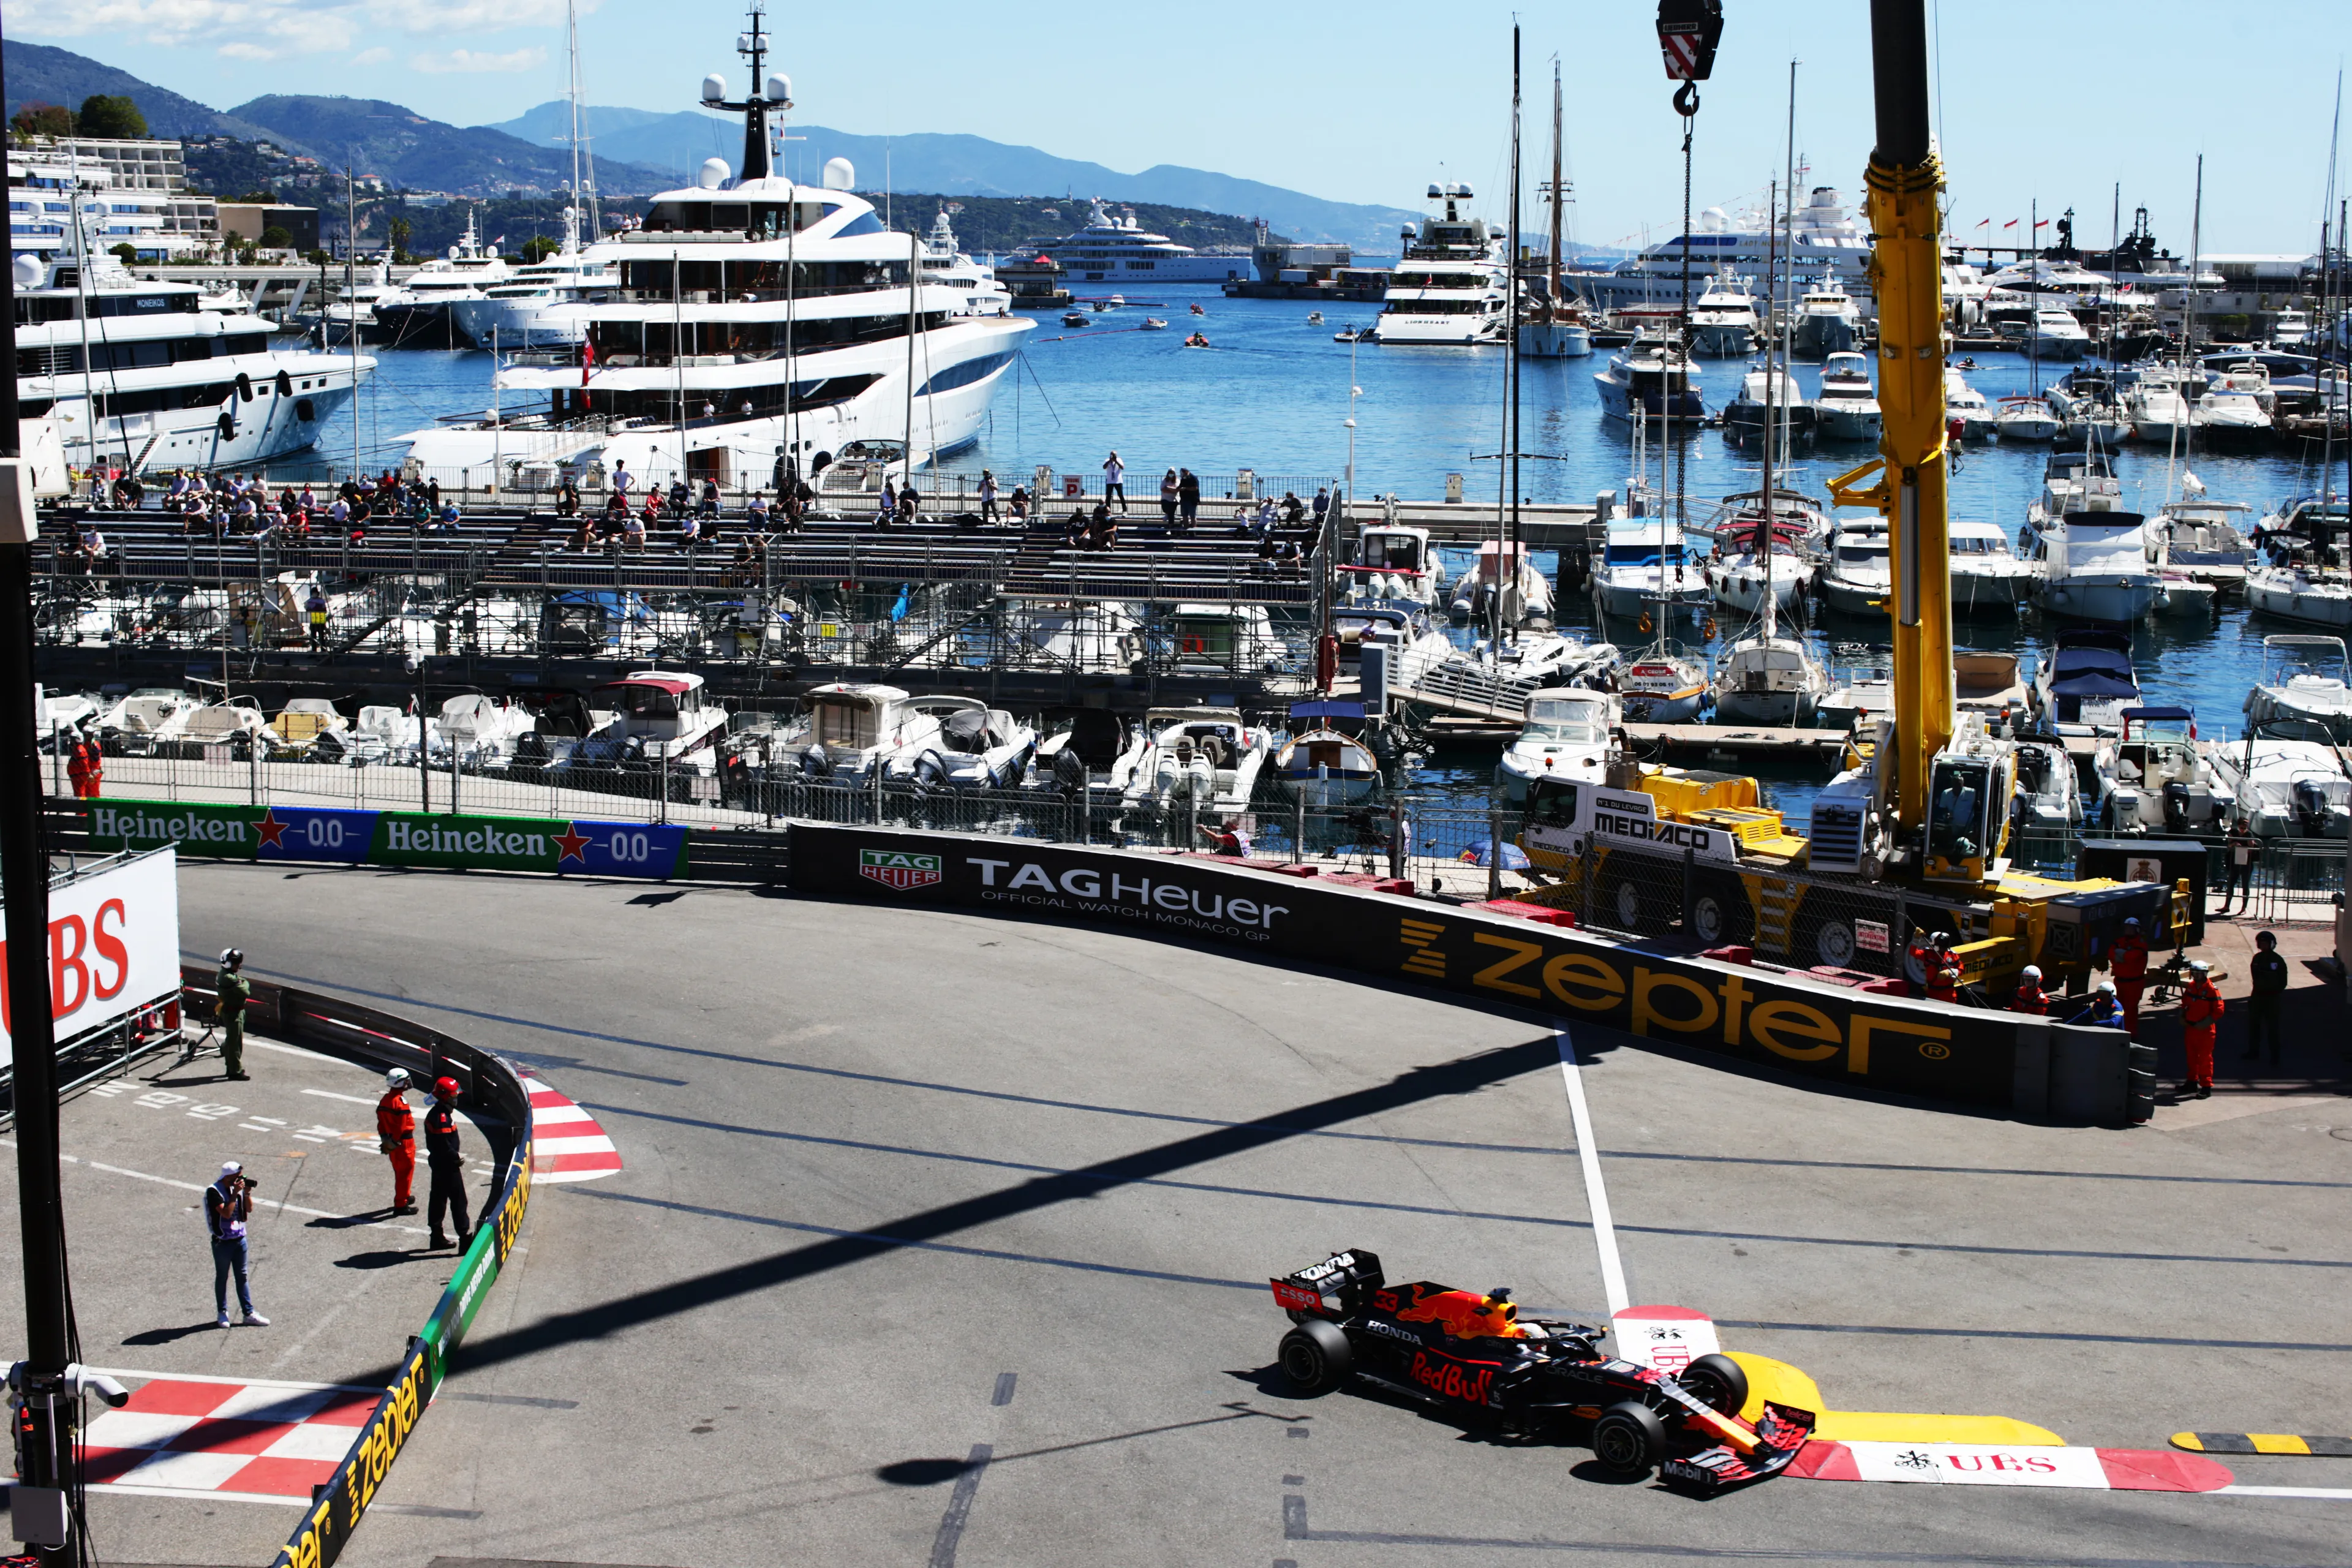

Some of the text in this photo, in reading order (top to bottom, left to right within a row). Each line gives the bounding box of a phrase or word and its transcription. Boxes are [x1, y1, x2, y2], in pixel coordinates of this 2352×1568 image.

[137, 298, 165, 308] MONEIKOS
[1067, 484, 1077, 496] P
[1621, 803, 1648, 813] LEVAGE
[94, 808, 343, 848] Heineken 0.0
[387, 821, 648, 862] Heineken 0.0
[865, 851, 934, 869] TAG
[864, 867, 940, 886] HEUER
[981, 891, 1271, 942] OFFICIAL WATCH MONACO GP
[459, 1289, 472, 1318] DRIVE
[469, 1263, 483, 1297] NEVER
[481, 1241, 496, 1273] DRINK
[1373, 1289, 1399, 1313] 33
[1366, 1320, 1423, 1346] HONDA
[1545, 1365, 1604, 1384] ORACLE
[1785, 1408, 1812, 1423] telcel
[1664, 1460, 1712, 1483] Mobil 1
[1945, 1453, 2057, 1474] UBS
